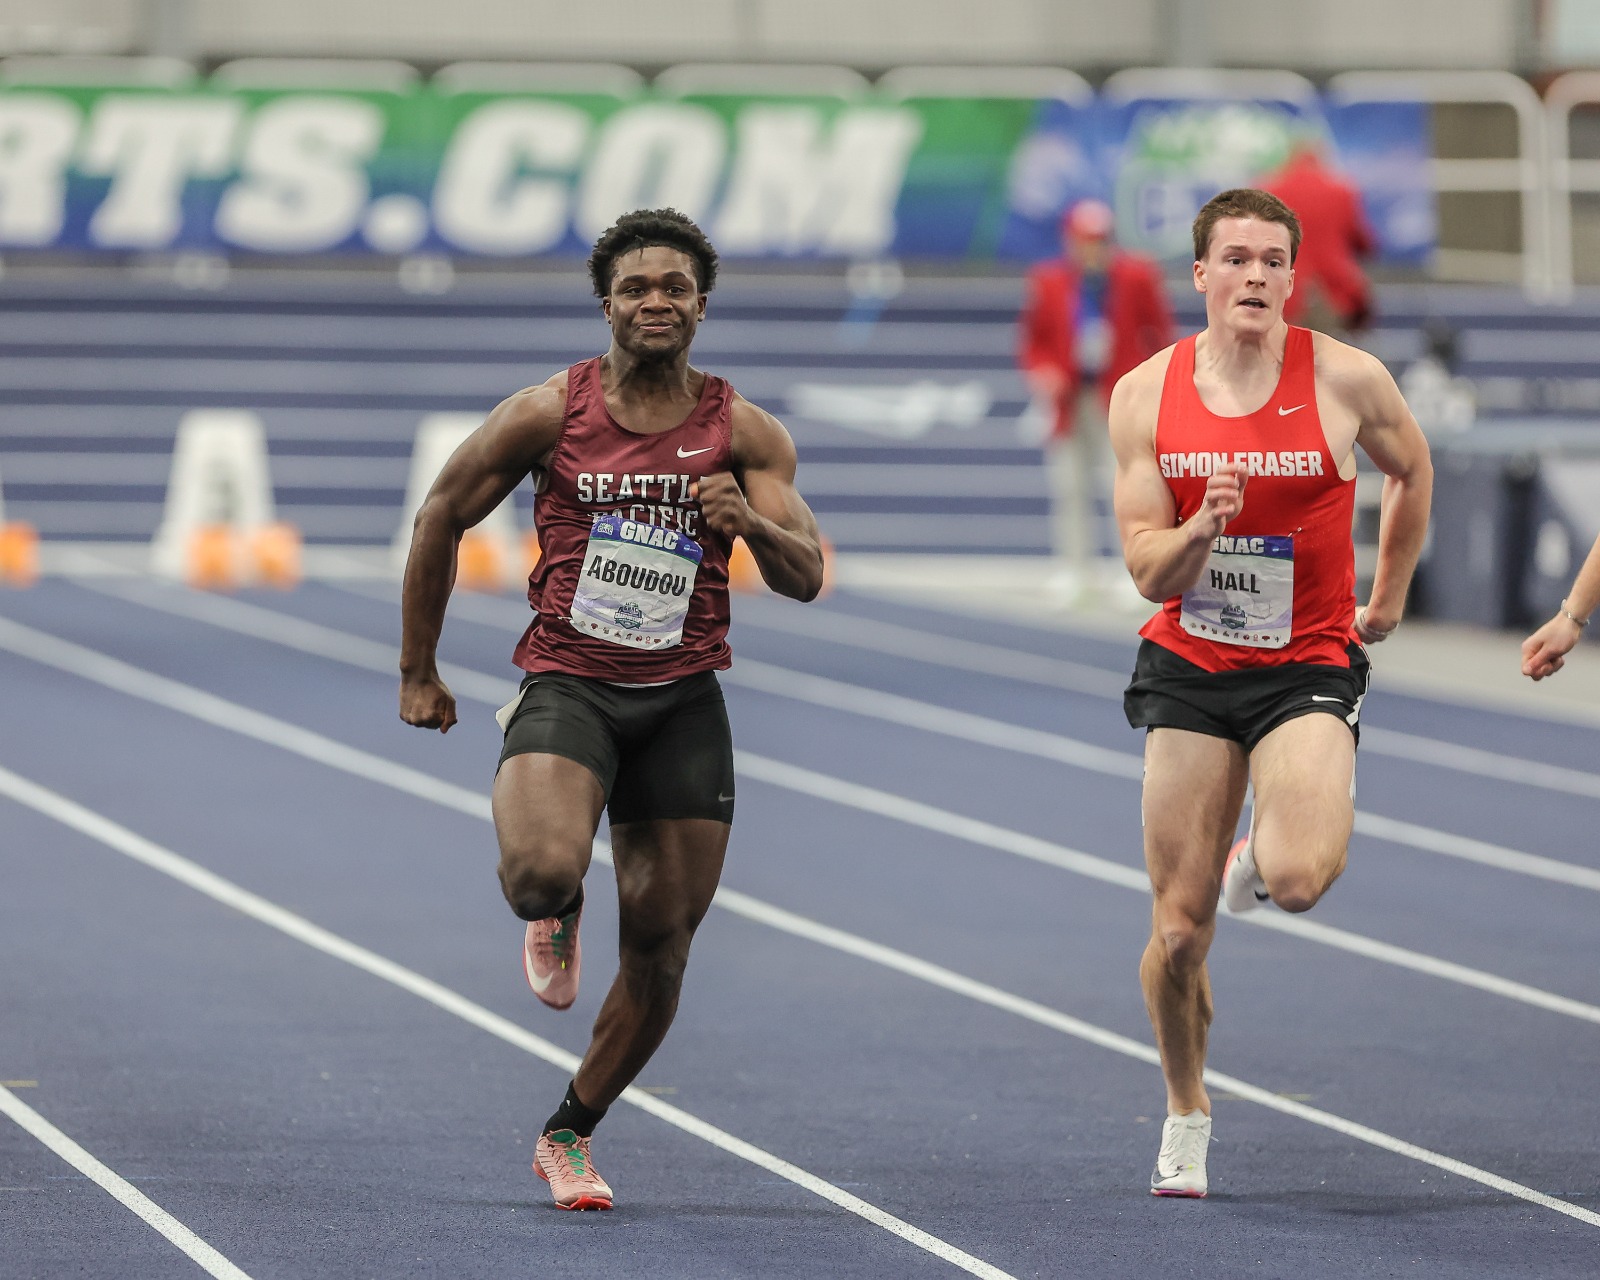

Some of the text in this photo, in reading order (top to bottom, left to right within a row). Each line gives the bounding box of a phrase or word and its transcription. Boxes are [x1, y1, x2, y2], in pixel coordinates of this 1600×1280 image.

[1160, 451, 1324, 478] SIMON FRASER
[577, 472, 708, 503] SEATTL
[619, 521, 679, 550] GNAC
[587, 555, 687, 597] ABOUDOU
[1210, 569, 1261, 594] HALL
